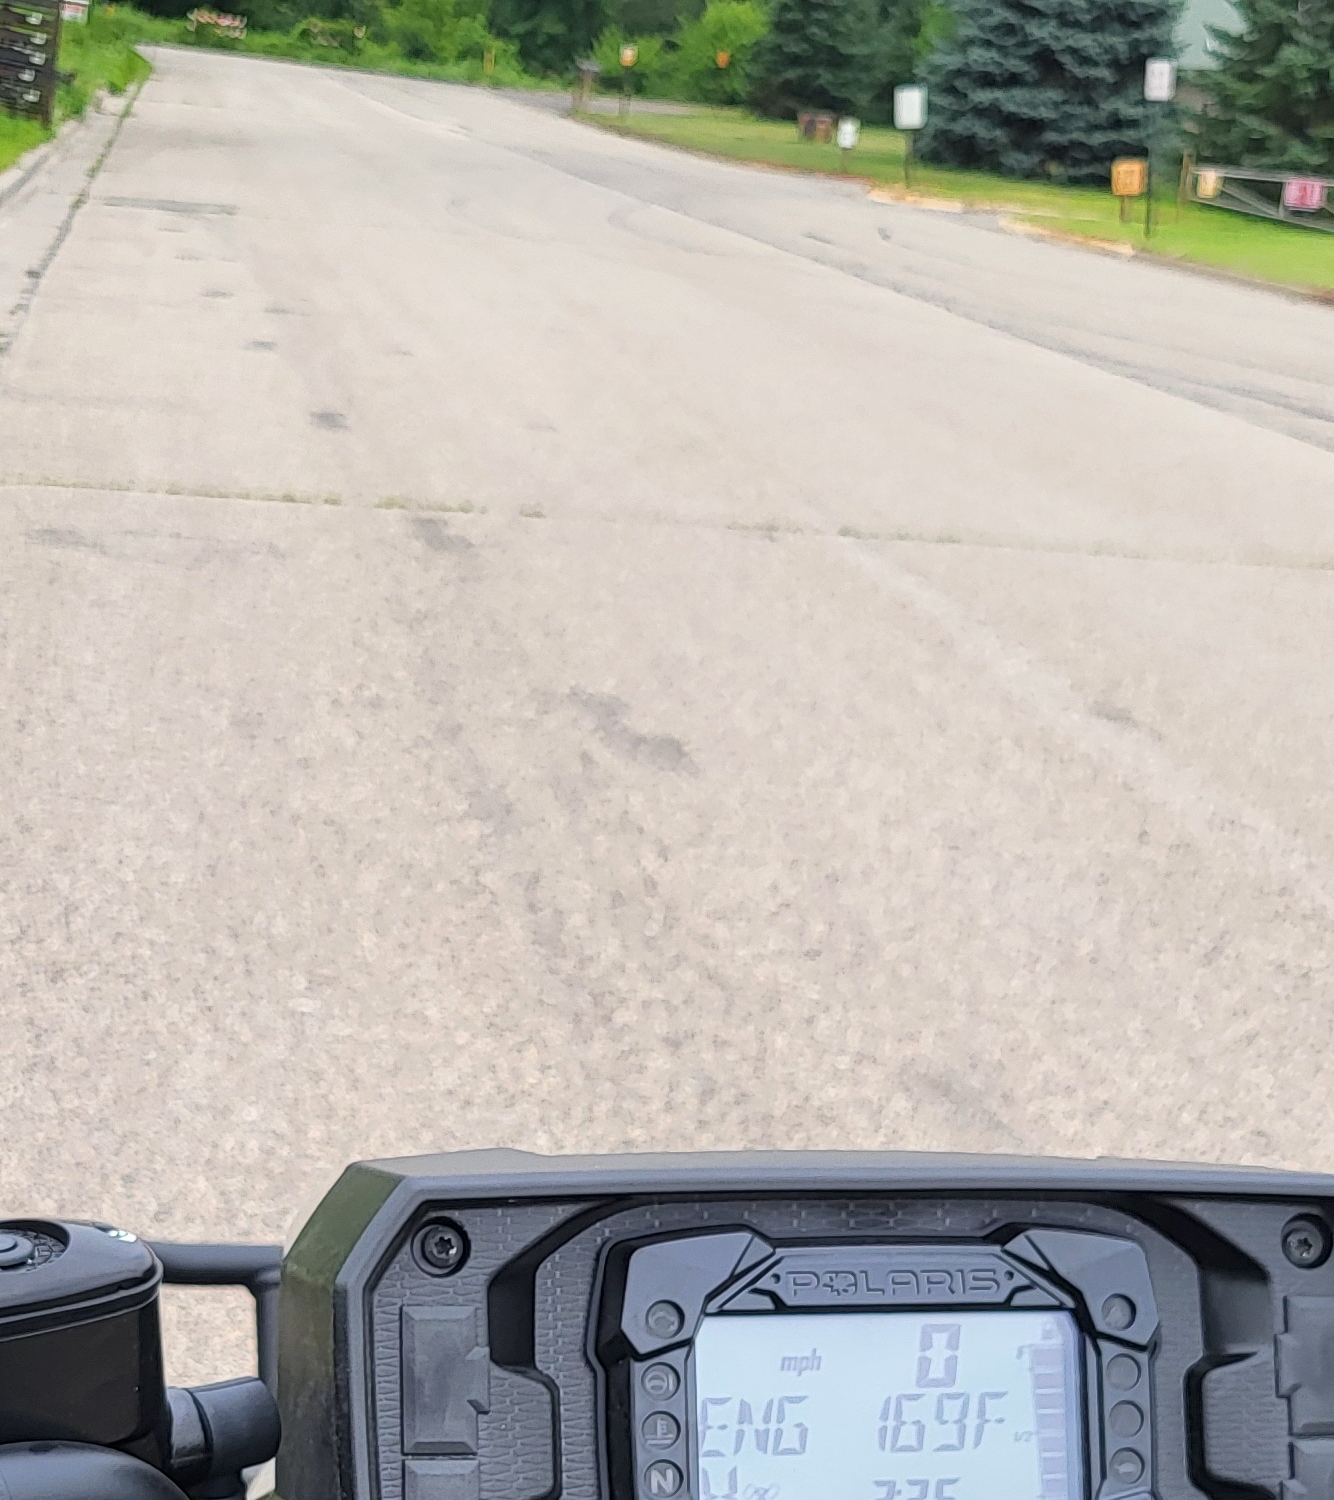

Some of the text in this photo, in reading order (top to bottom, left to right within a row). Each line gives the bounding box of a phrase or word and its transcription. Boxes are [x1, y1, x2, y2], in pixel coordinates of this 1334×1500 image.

[785, 1268, 1000, 1297] POLARIS
[780, 1348, 821, 1375] mph
[916, 1323, 961, 1388] 0
[700, 1395, 809, 1458] ENG
